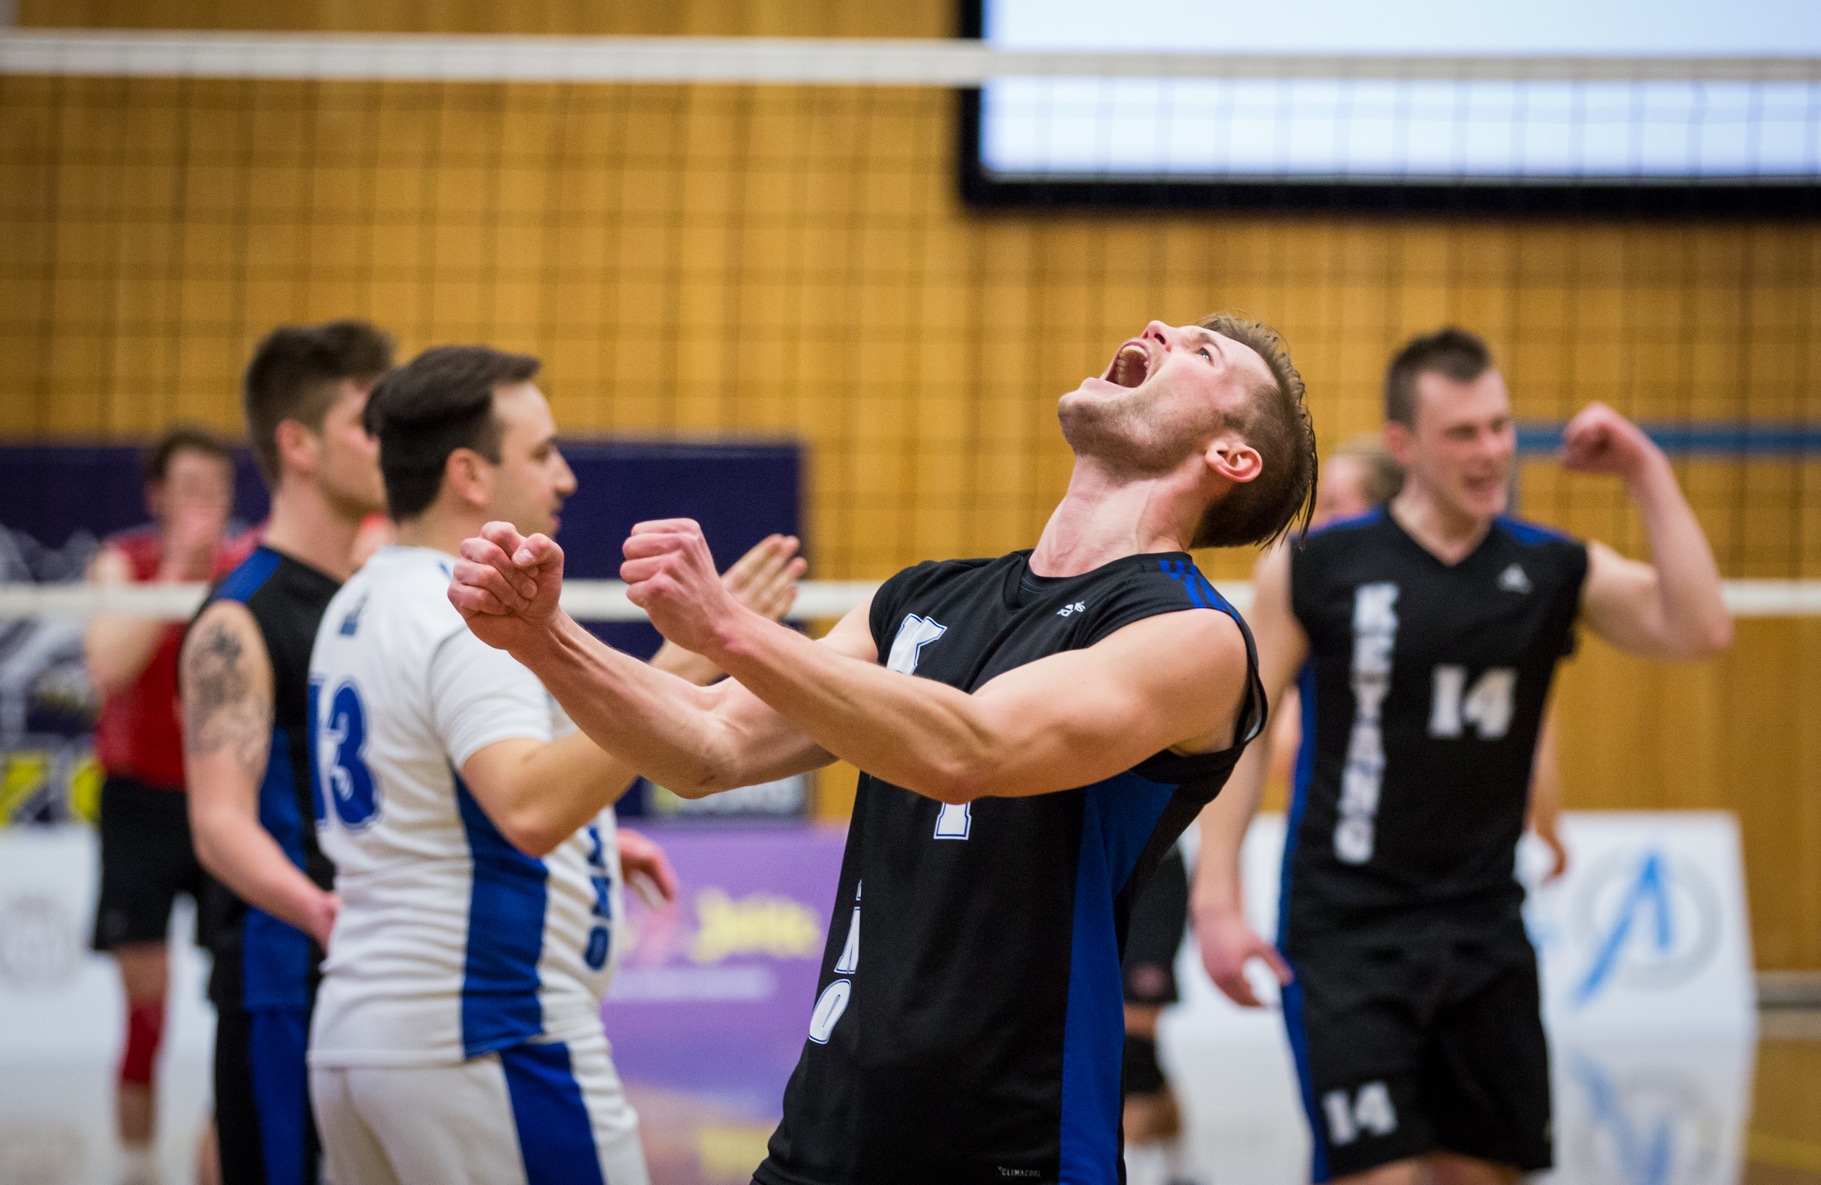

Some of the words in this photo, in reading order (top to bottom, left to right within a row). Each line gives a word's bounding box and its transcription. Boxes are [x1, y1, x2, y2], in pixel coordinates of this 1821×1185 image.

[1427, 663, 1518, 740] 14
[307, 674, 386, 832] 13
[1321, 1081, 1398, 1146] 14
